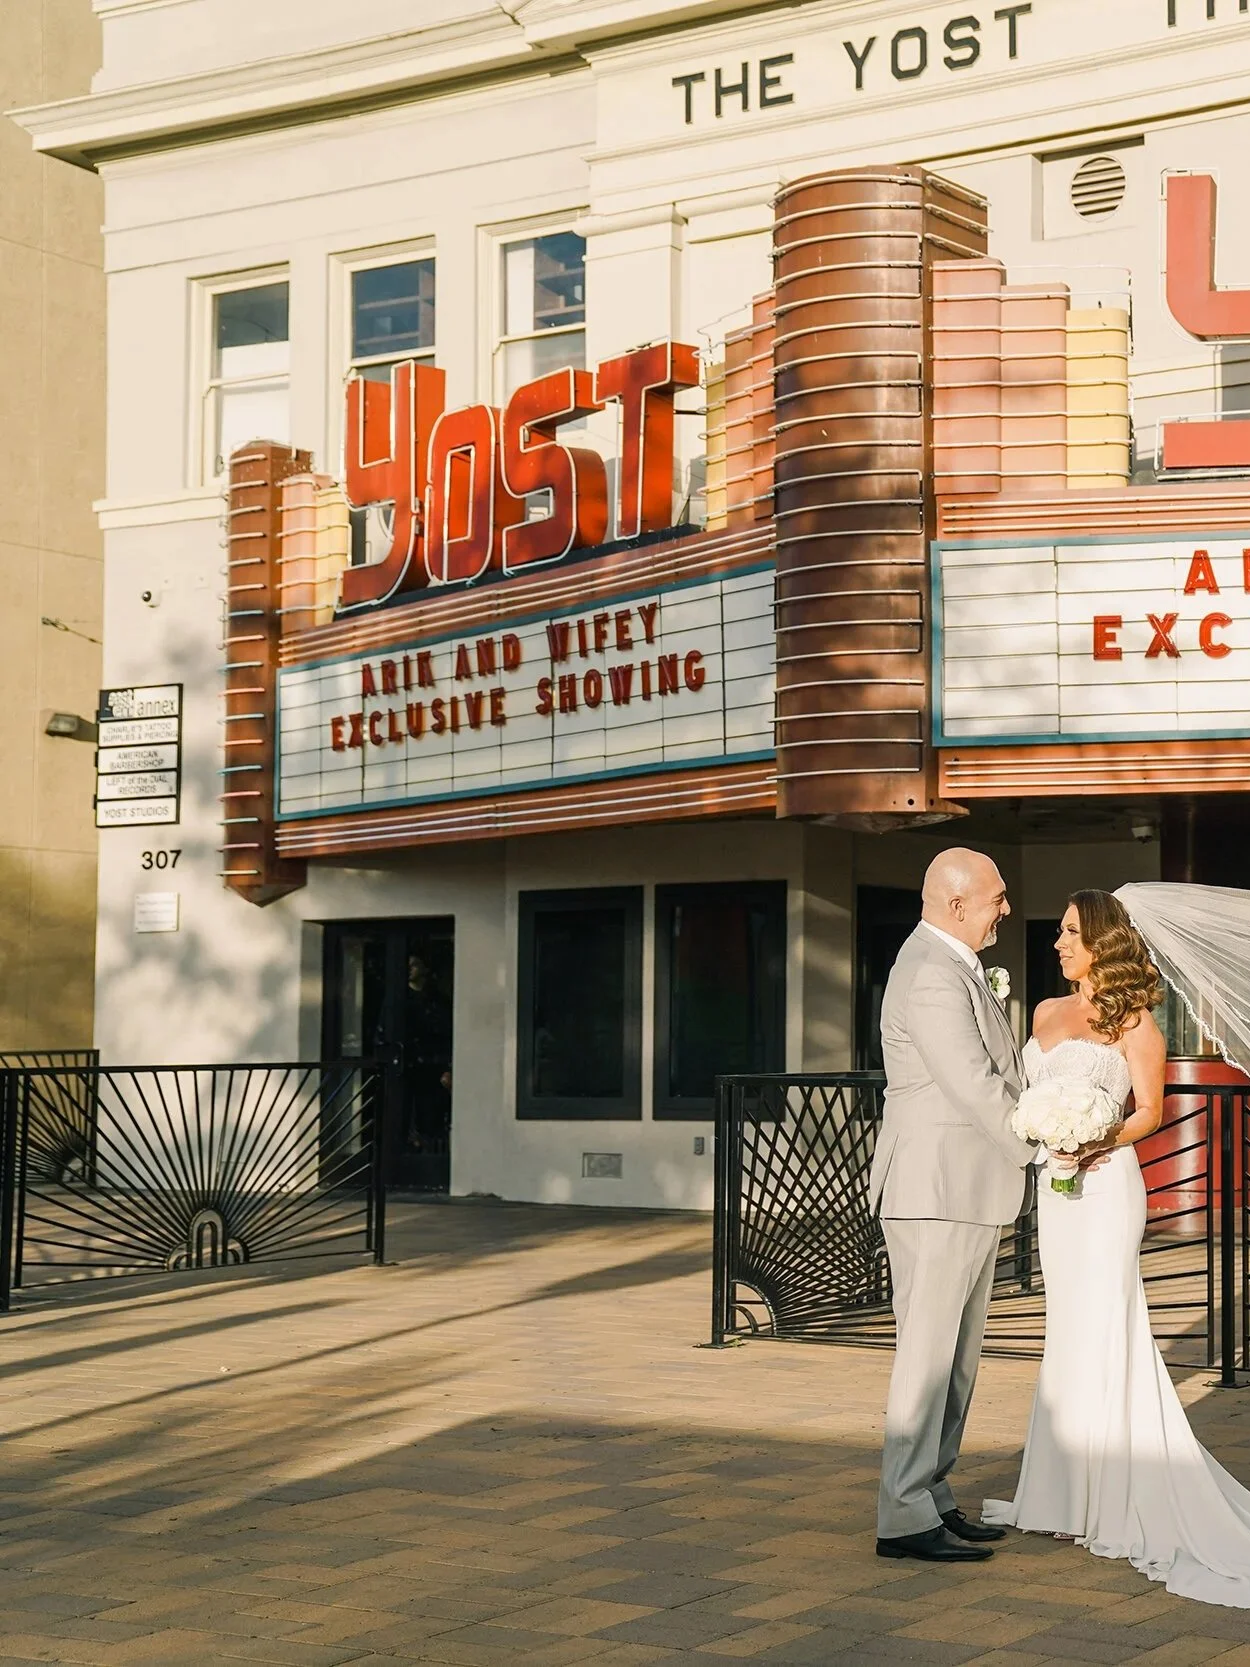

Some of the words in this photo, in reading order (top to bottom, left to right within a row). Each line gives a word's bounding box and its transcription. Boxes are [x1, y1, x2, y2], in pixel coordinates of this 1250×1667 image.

[672, 53, 794, 125] THE
[843, 2, 1032, 91] YOST
[336, 337, 698, 613] YOST
[361, 650, 435, 699] ARIK
[455, 633, 521, 682] AND
[546, 602, 658, 662] WIFEY
[137, 699, 176, 716] annex
[331, 687, 507, 752] EXCLUSIVE
[536, 650, 706, 716] SHOWING
[104, 807, 127, 819] YOST
[129, 806, 169, 818] STUDIOS
[142, 849, 182, 870] 307
